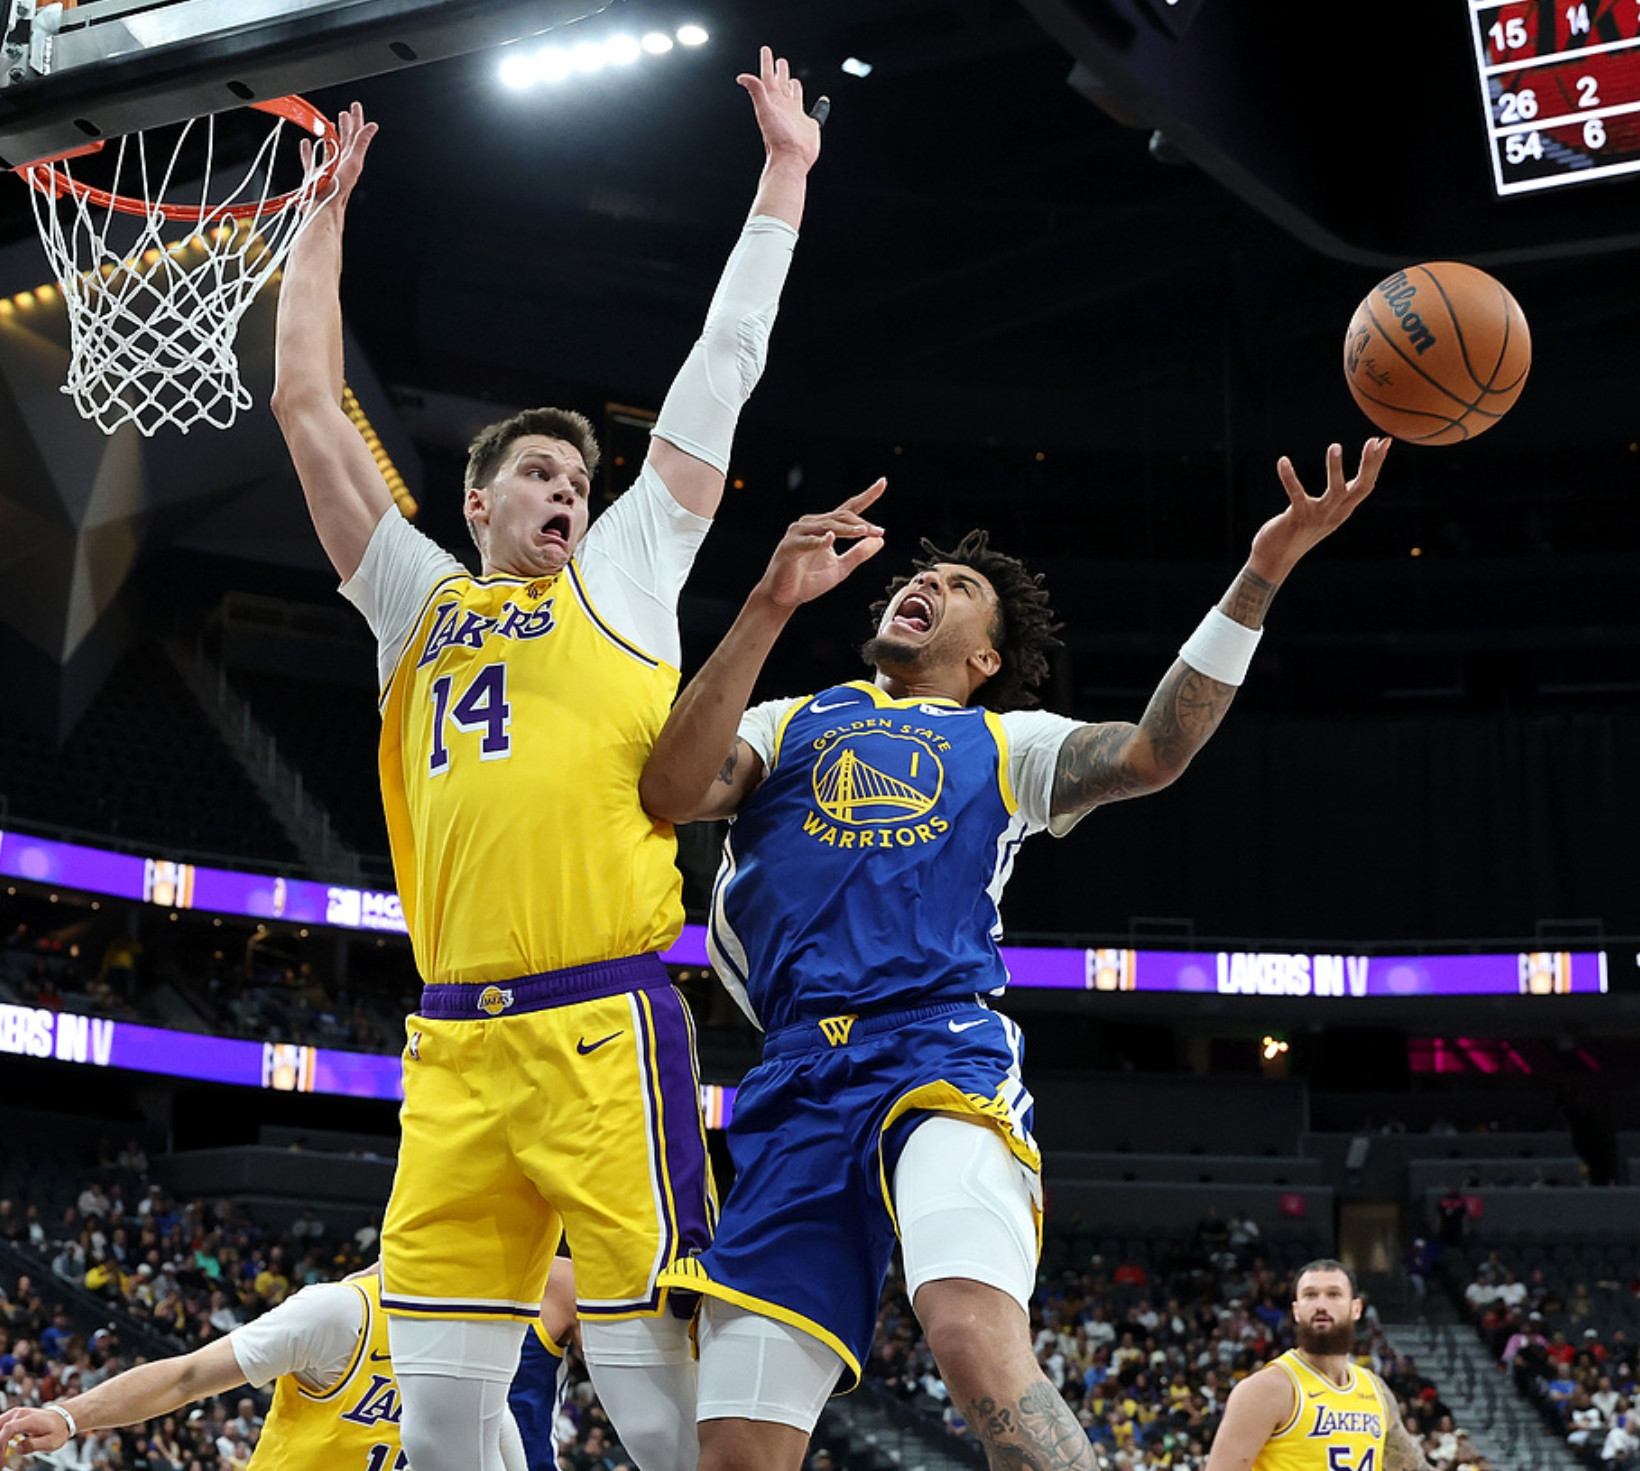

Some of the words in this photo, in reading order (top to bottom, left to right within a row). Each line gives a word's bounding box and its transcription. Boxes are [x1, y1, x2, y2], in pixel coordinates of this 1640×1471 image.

[1488, 17, 1527, 51] 15
[1565, 3, 1591, 36] 14
[1497, 89, 1539, 124] 26
[1576, 75, 1601, 108] 2
[1505, 130, 1545, 164] 54
[1583, 119, 1606, 149] 6
[416, 599, 556, 670] LAKRS
[428, 661, 513, 779] 14
[812, 718, 893, 750] GOLDEN
[899, 724, 951, 752] STATE
[909, 751, 920, 778] 1
[802, 811, 949, 849] WARRIORS
[1217, 951, 1311, 996] LAKERS
[1313, 954, 1345, 997] IN
[1346, 956, 1369, 998] V
[55, 1012, 89, 1063] IN
[91, 1018, 115, 1067] V
[1307, 1404, 1382, 1439] LAKERS
